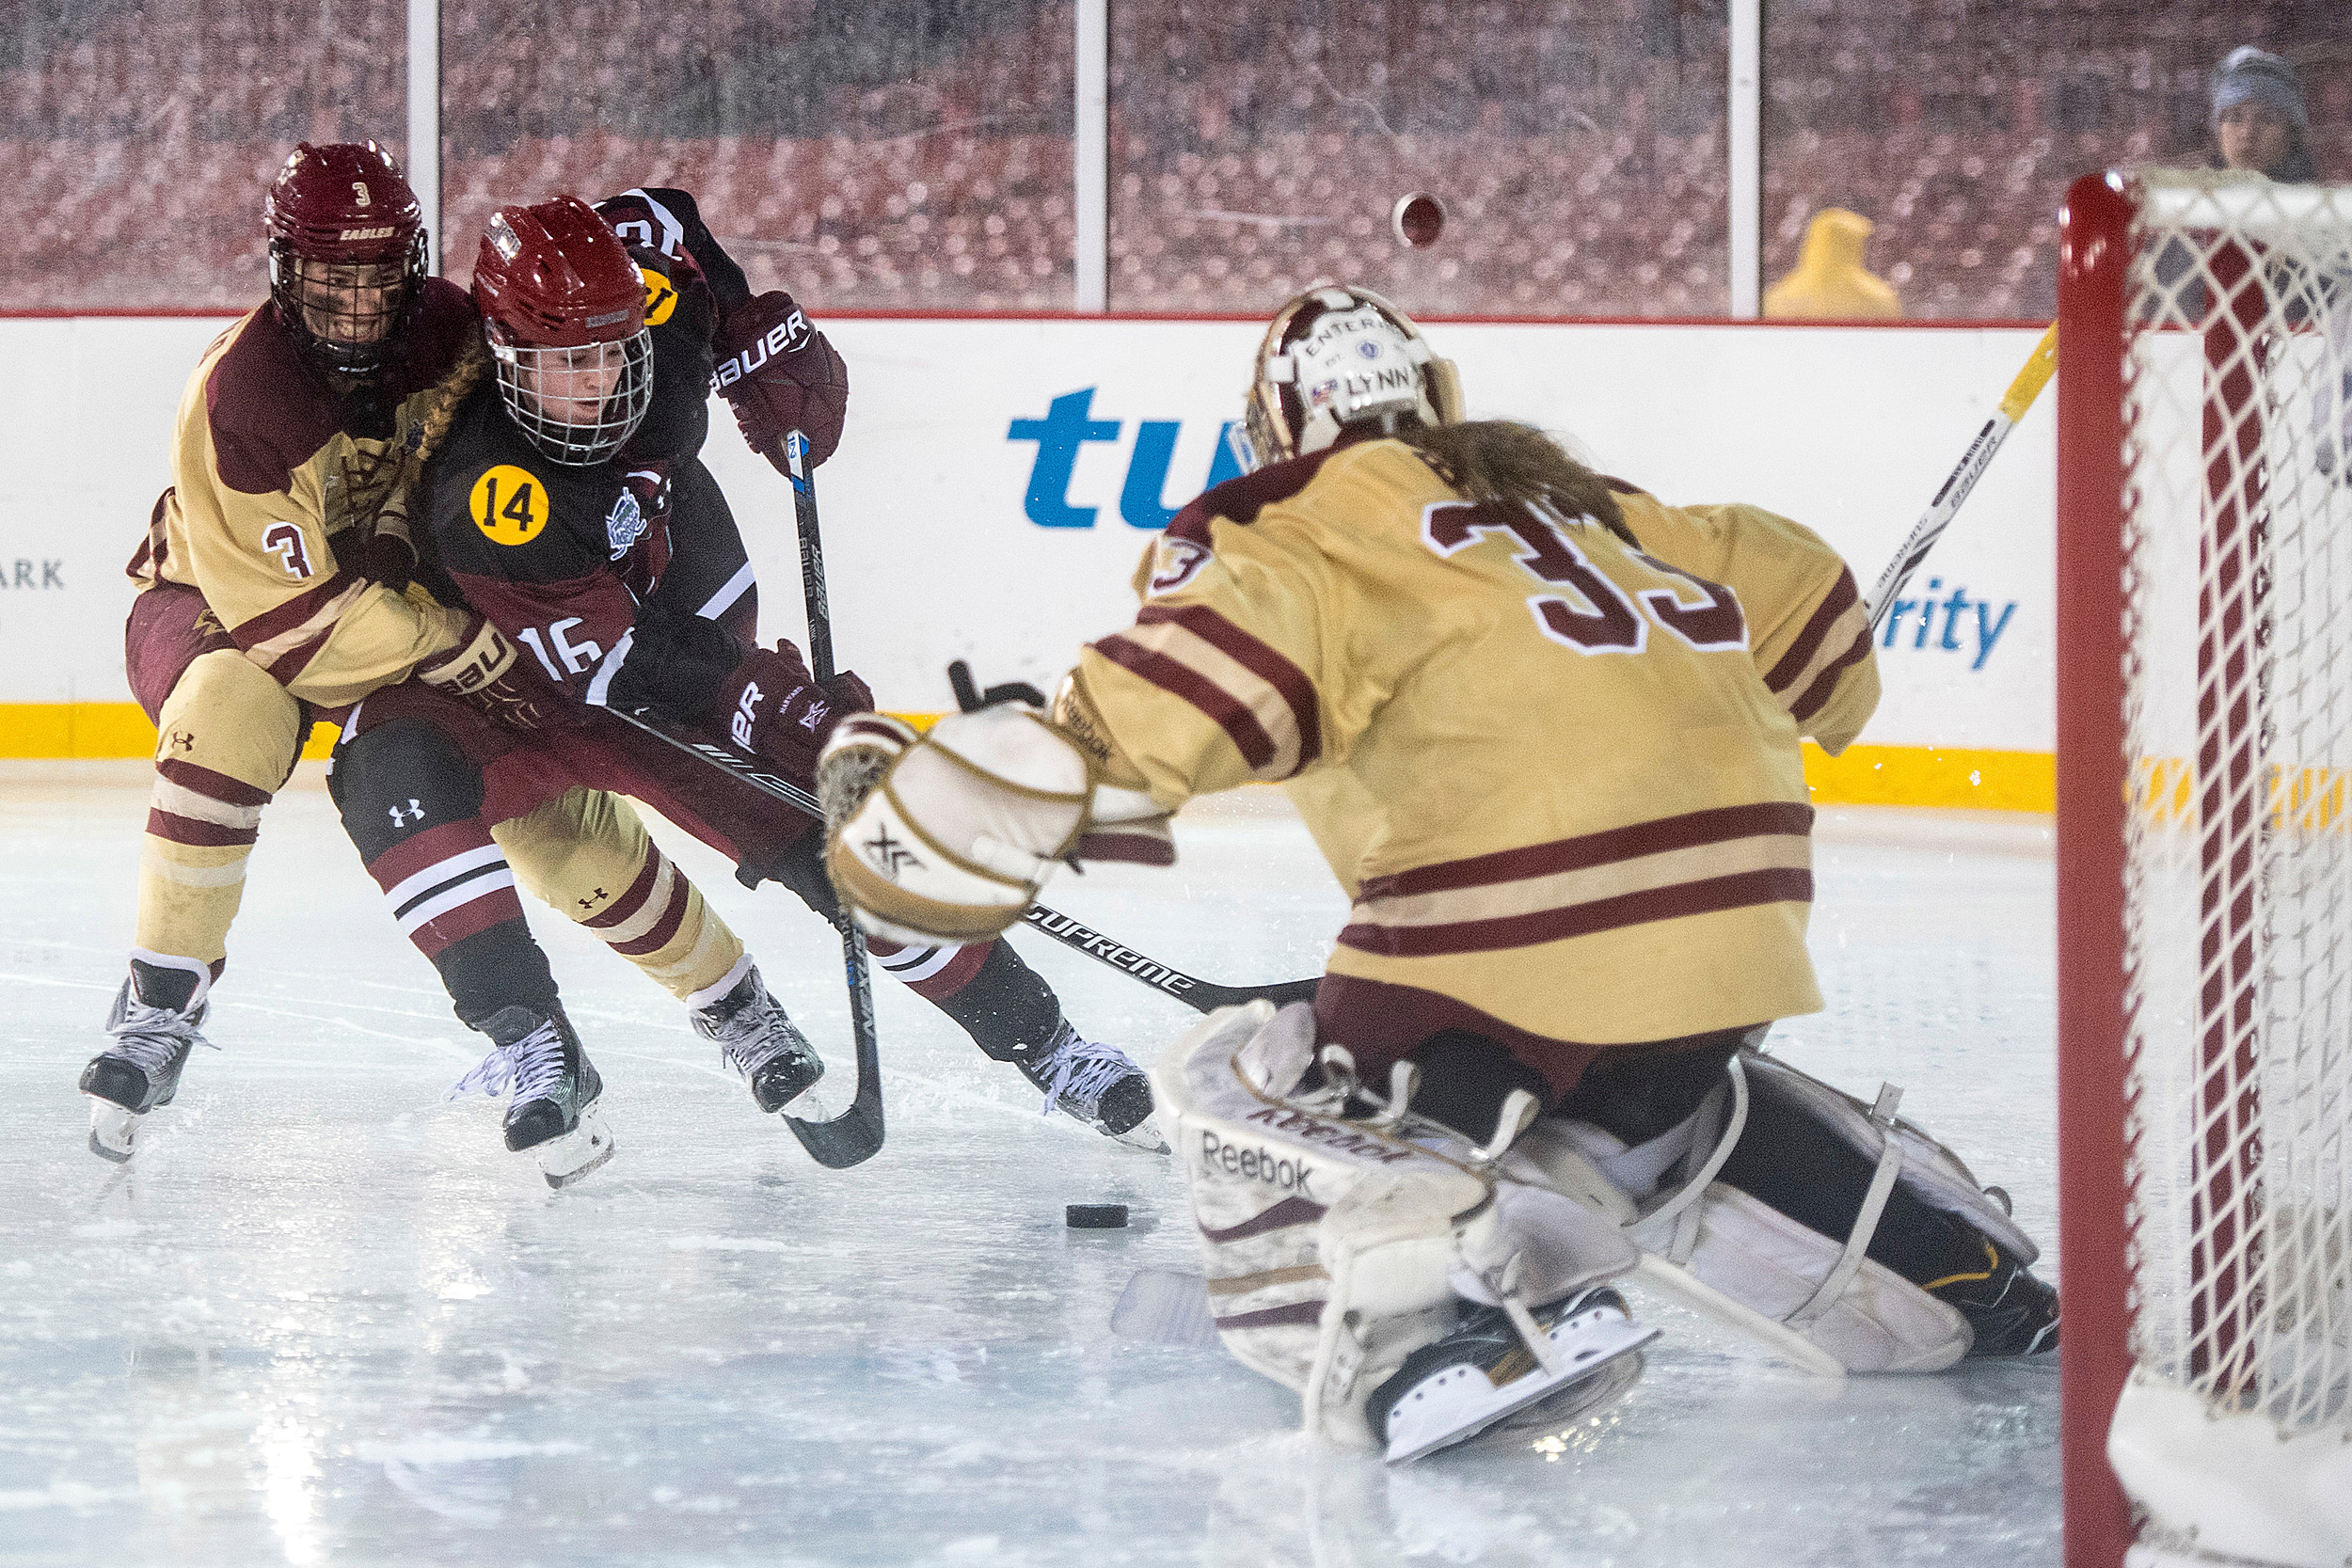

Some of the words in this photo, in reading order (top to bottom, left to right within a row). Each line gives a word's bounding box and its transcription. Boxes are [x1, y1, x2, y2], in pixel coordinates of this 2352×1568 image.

[352, 182, 372, 207] 3
[340, 226, 395, 241] EAGLES
[483, 478, 533, 531] 14
[262, 521, 314, 579] 3
[812, 544, 829, 620] BAUER
[1421, 500, 1748, 657] 33
[517, 617, 602, 681] 16
[1883, 578, 2017, 671] rity
[1202, 1130, 1315, 1201] Reebok
